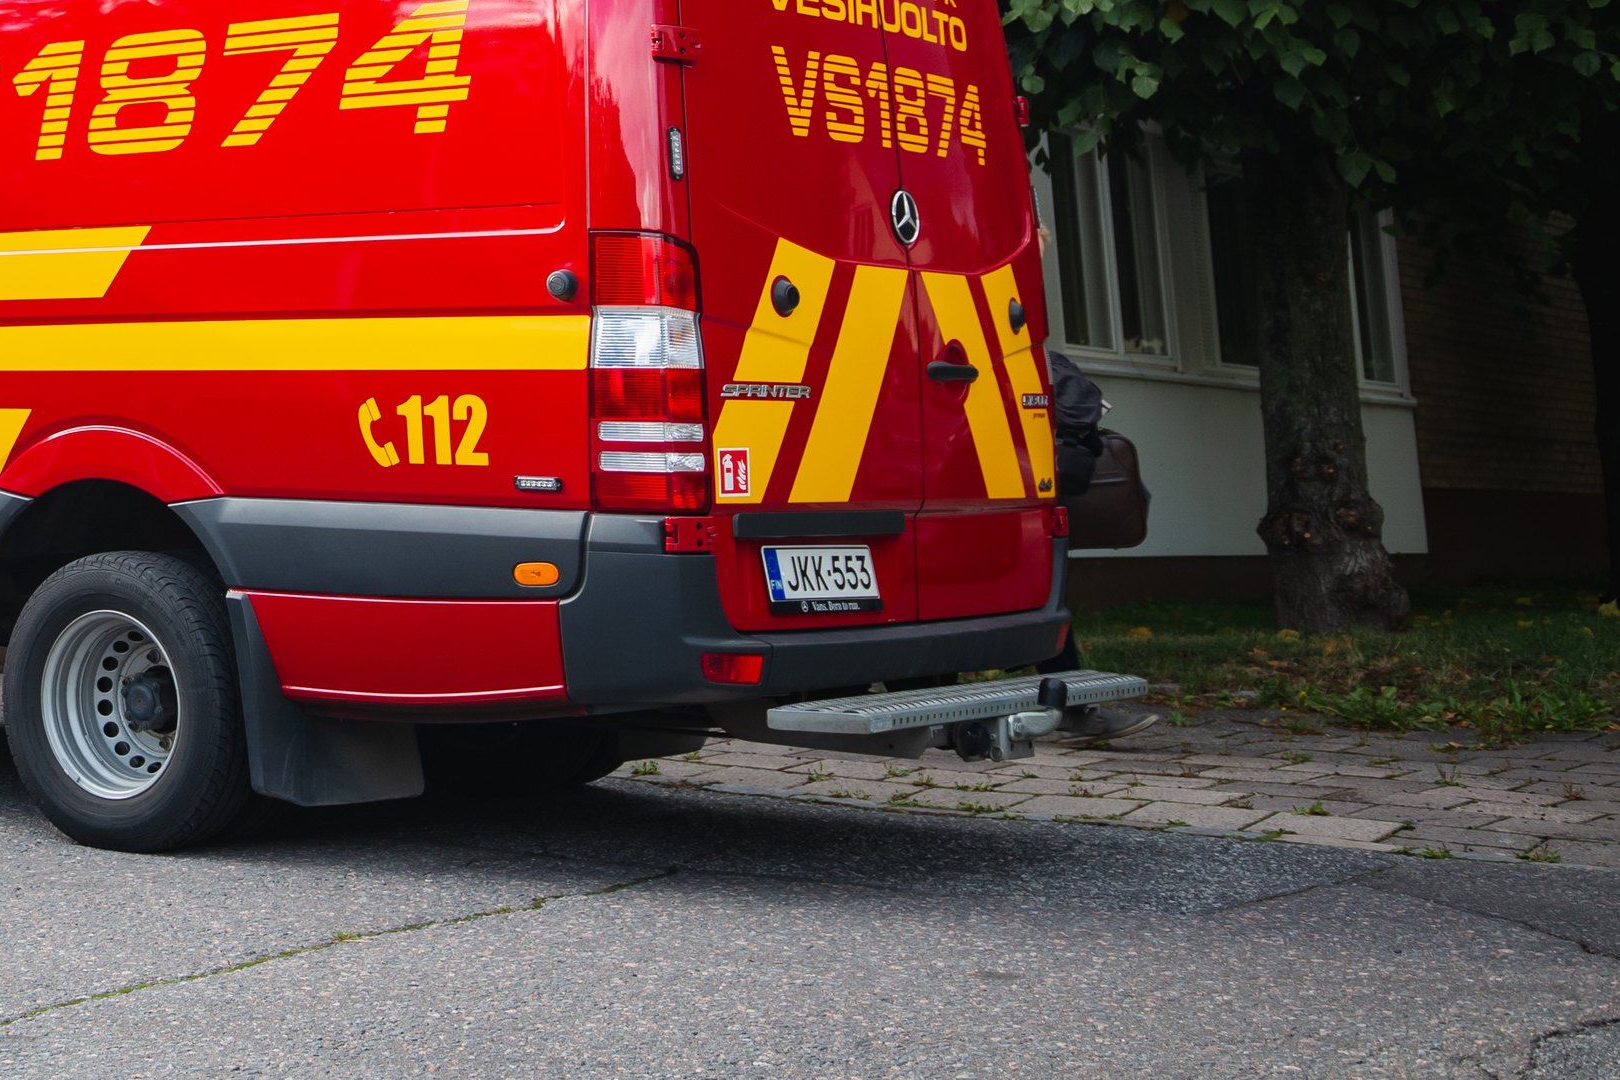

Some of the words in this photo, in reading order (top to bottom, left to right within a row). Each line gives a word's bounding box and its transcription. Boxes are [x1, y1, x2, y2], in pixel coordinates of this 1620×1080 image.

[771, 45, 987, 166] VS1874
[720, 383, 811, 399] SPRINTER
[396, 394, 489, 467] 112
[787, 555, 872, 592] JKK-553
